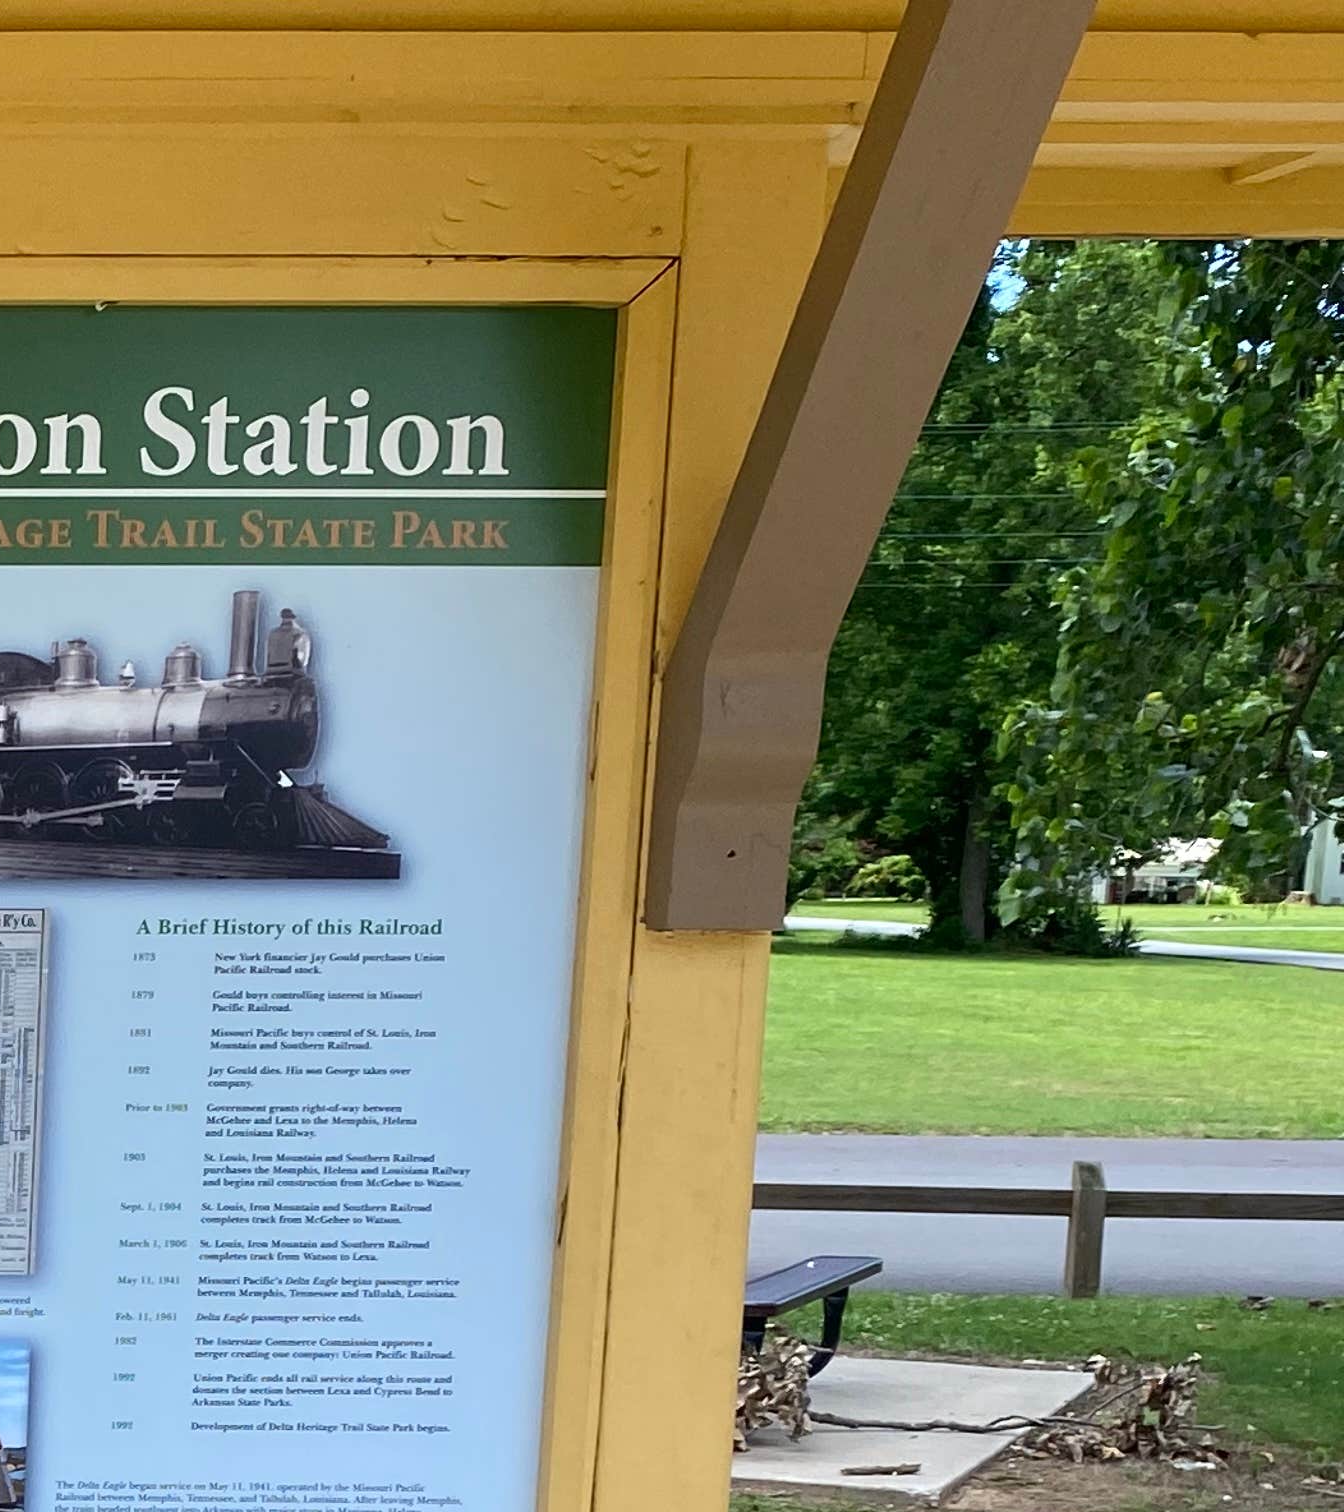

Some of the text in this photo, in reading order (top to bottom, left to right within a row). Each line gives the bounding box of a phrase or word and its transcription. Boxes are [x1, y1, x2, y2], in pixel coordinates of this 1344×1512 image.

[141, 387, 509, 476] Station
[87, 509, 225, 549] TRAIL
[239, 512, 373, 549] STATE
[392, 510, 507, 549] PARK
[137, 919, 442, 939] A Brief History of this Railroad
[215, 965, 246, 974] Pacific
[295, 966, 322, 974] stock.
